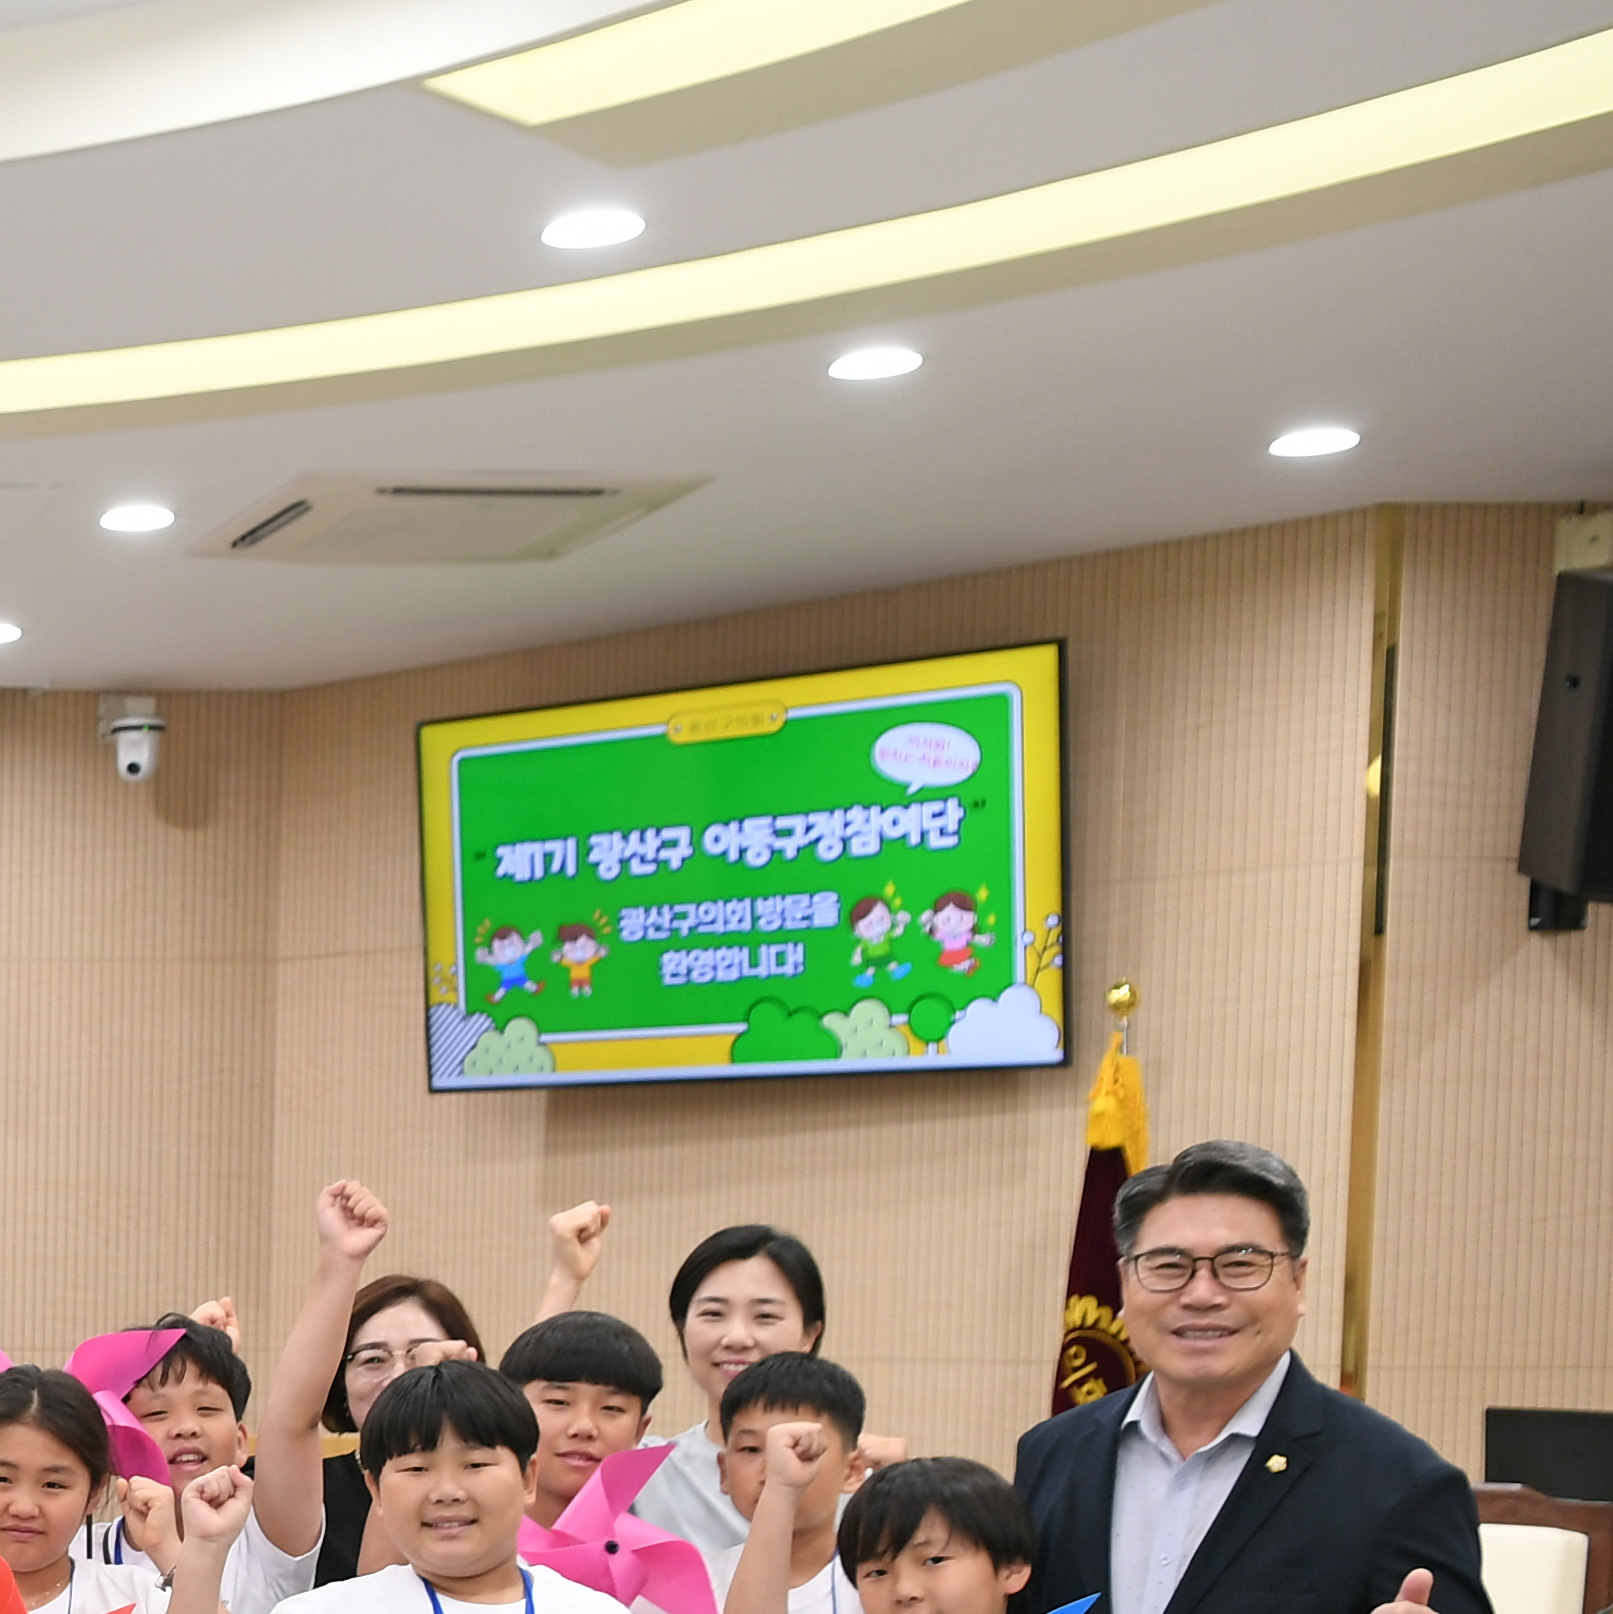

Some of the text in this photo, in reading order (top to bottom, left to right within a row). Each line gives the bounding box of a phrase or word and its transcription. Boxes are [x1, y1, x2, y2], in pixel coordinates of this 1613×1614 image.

[587, 825, 695, 881] 광산구
[702, 796, 966, 868] 아동구정참여단
[618, 896, 753, 942] 광산구의회
